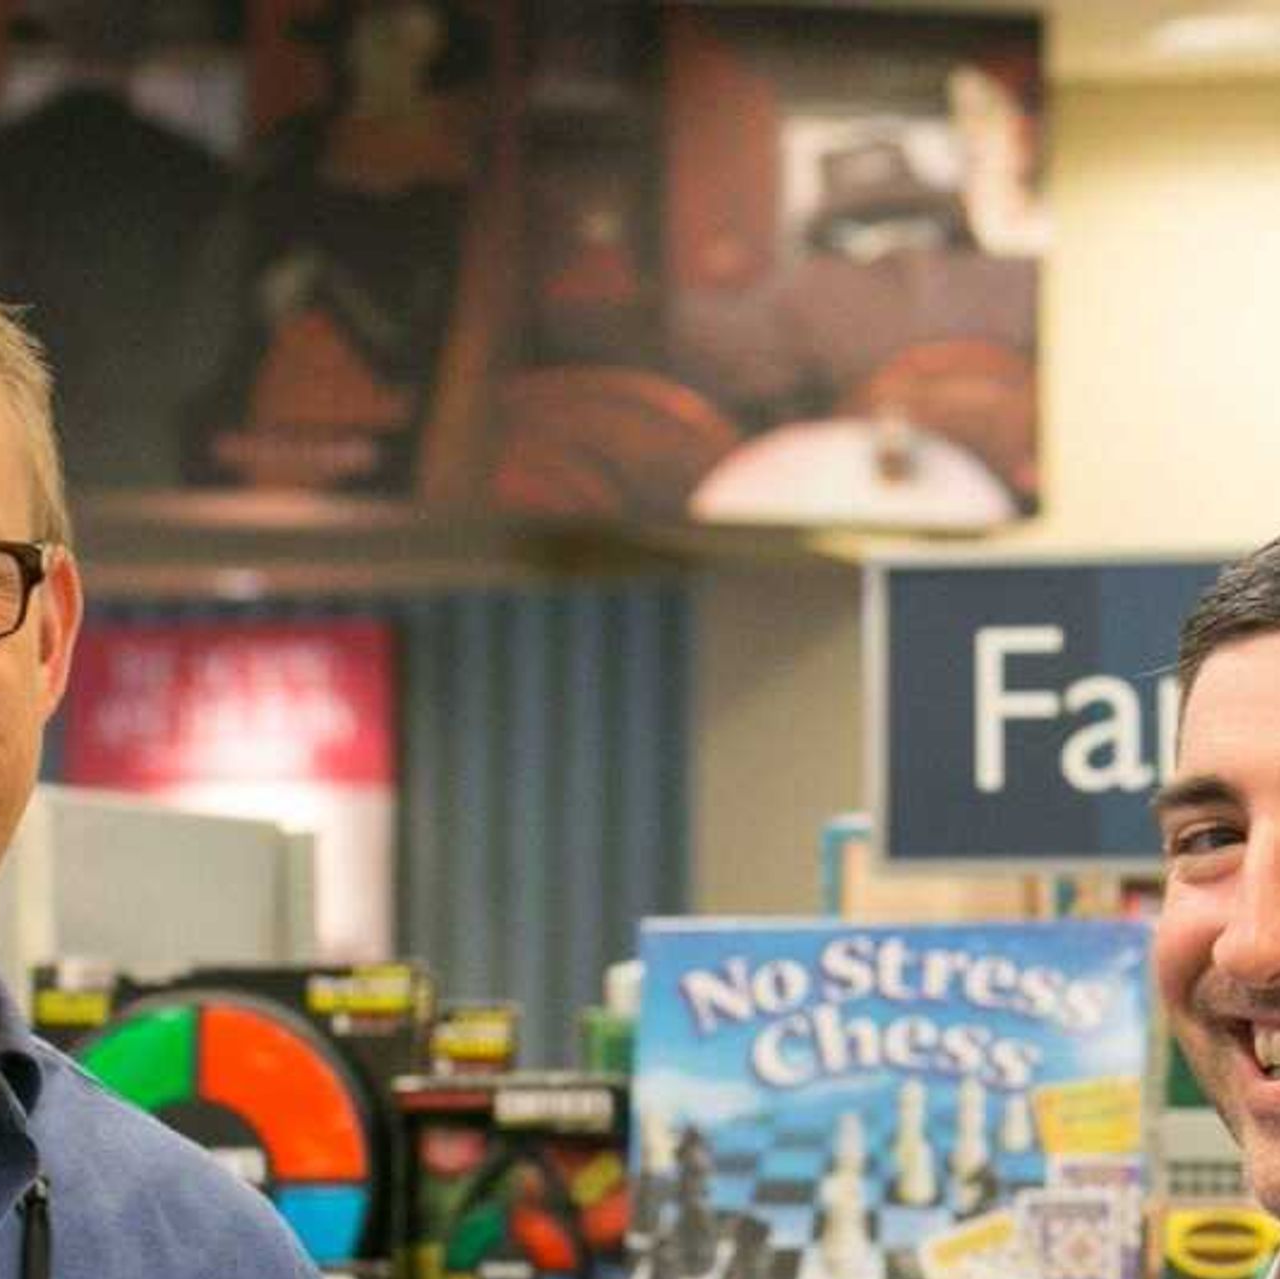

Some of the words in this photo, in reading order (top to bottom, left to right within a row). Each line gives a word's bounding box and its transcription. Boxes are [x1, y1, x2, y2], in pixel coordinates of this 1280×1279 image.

[678, 954, 811, 1038] No
[820, 935, 1108, 1033] Stress
[751, 1000, 1041, 1088] Chess
